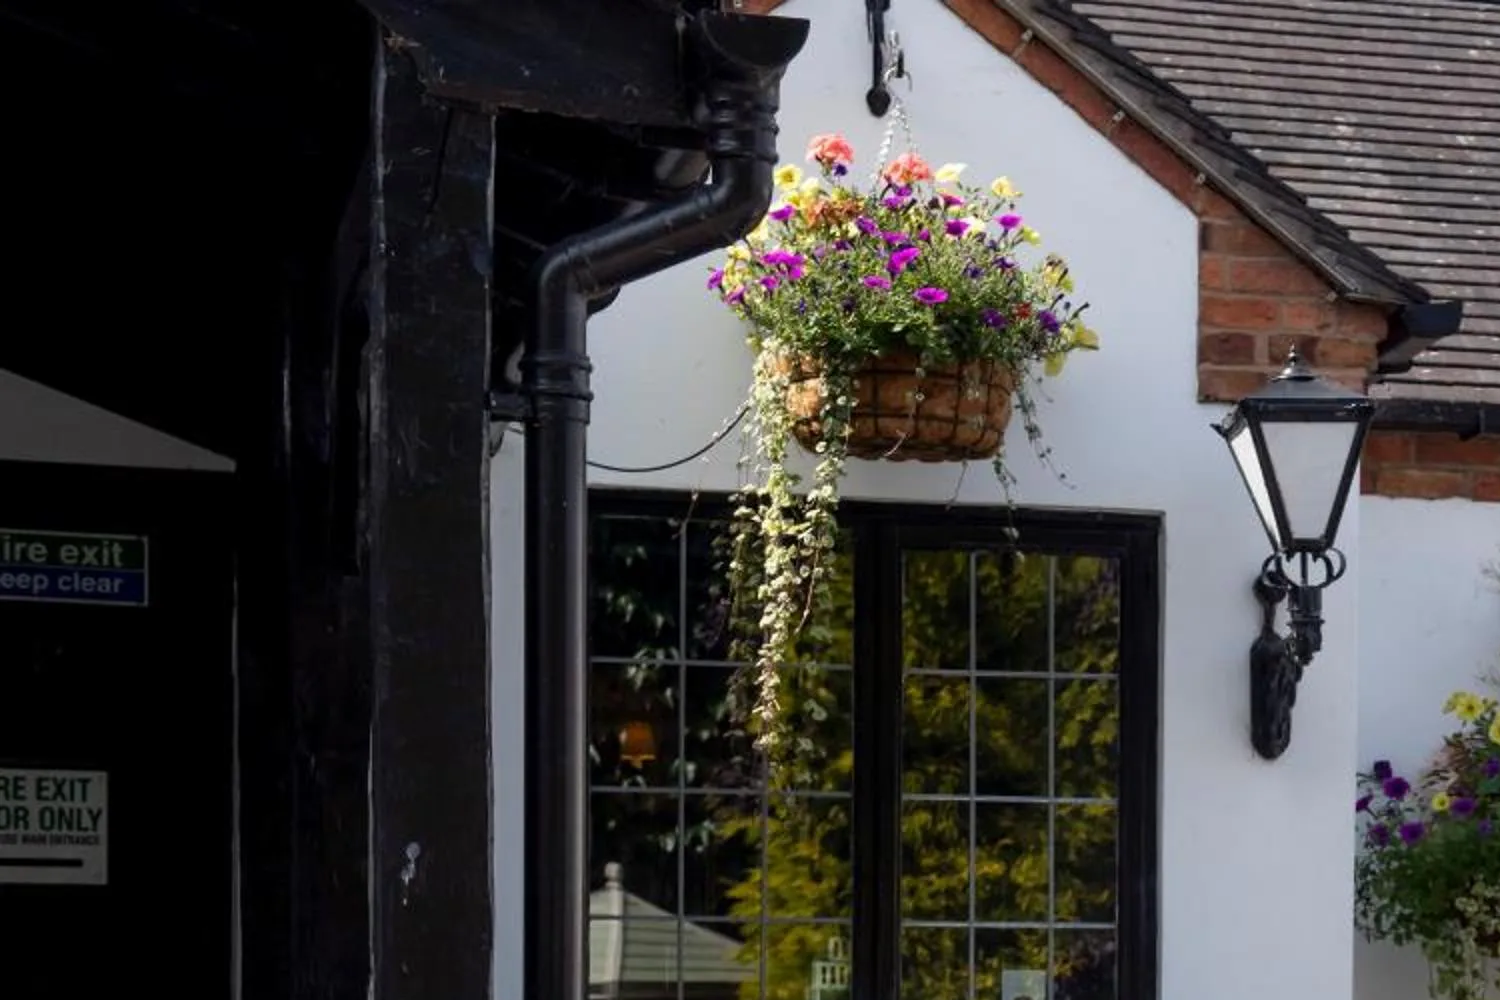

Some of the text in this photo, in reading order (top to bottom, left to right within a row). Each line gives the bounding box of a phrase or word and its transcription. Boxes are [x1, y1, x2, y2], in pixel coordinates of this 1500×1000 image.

[59, 540, 124, 568] exit
[57, 571, 125, 594] clear
[36, 777, 92, 803] EXIT
[39, 806, 103, 833] ONLY
